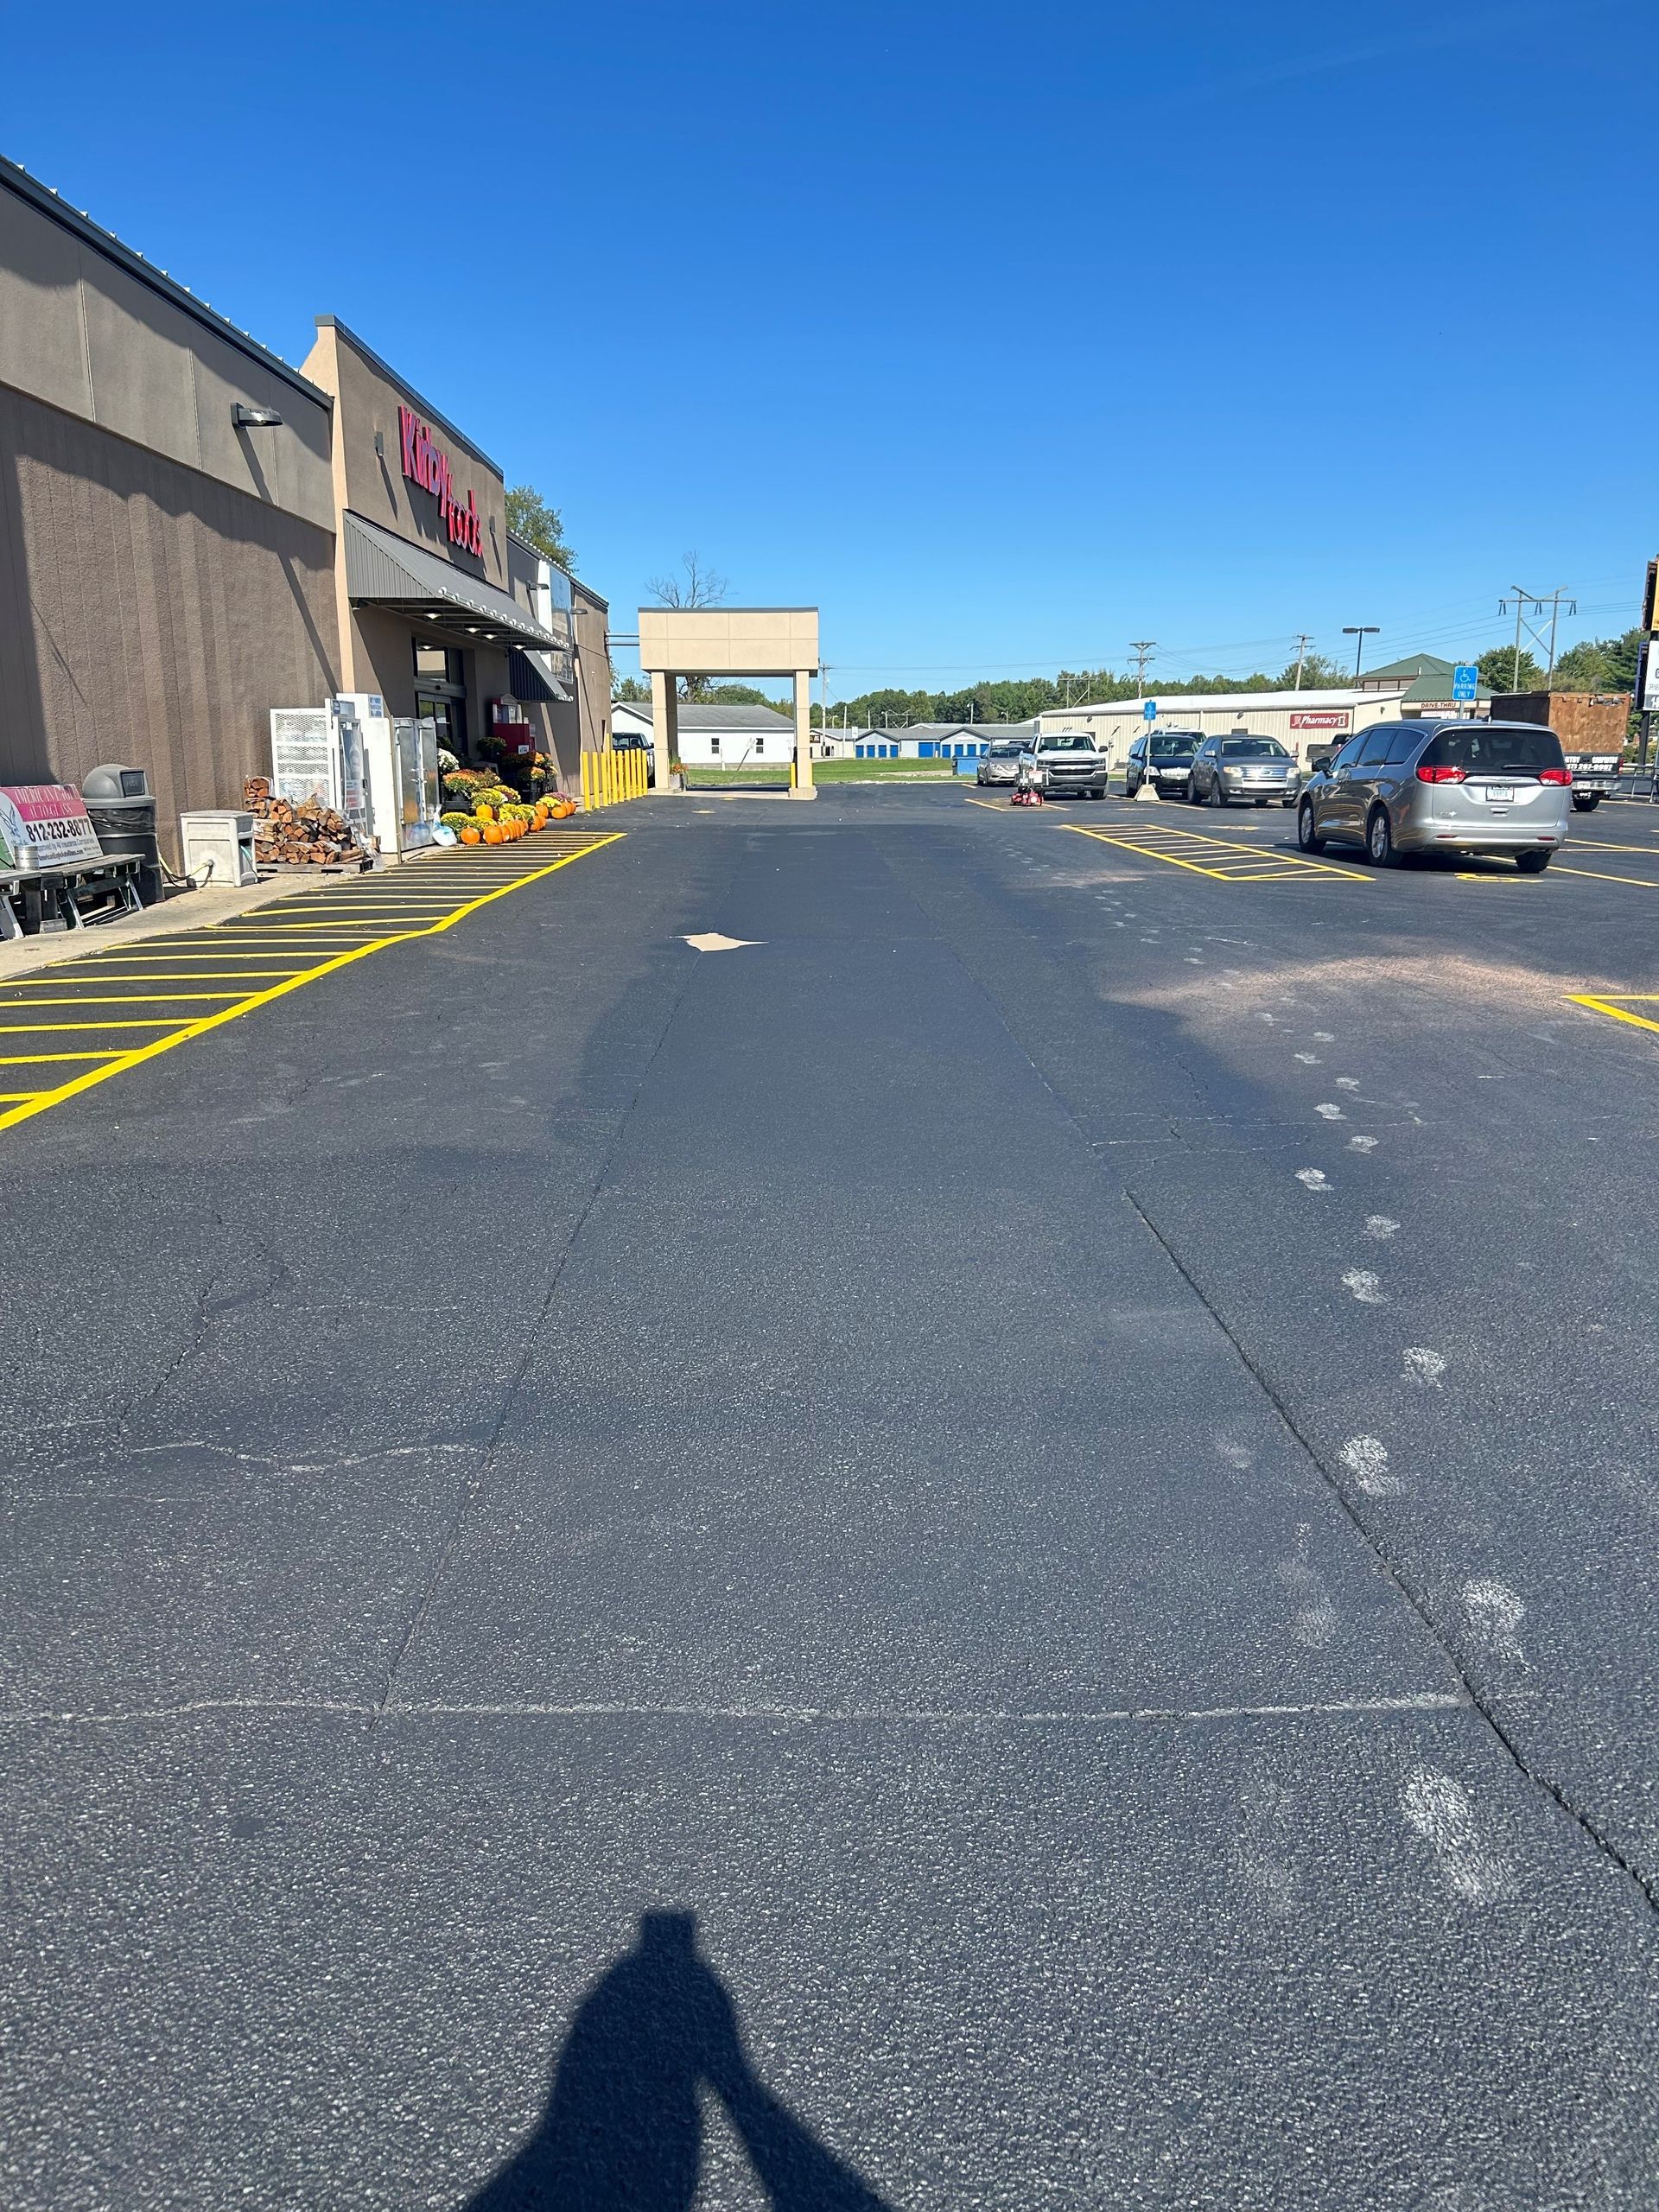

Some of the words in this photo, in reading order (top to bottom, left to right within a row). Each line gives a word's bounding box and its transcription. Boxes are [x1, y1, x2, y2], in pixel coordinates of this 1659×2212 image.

[398, 404, 448, 518] Kirby
[1301, 715, 1338, 727] Pharmacy
[14, 786, 54, 804] AMERICAN
